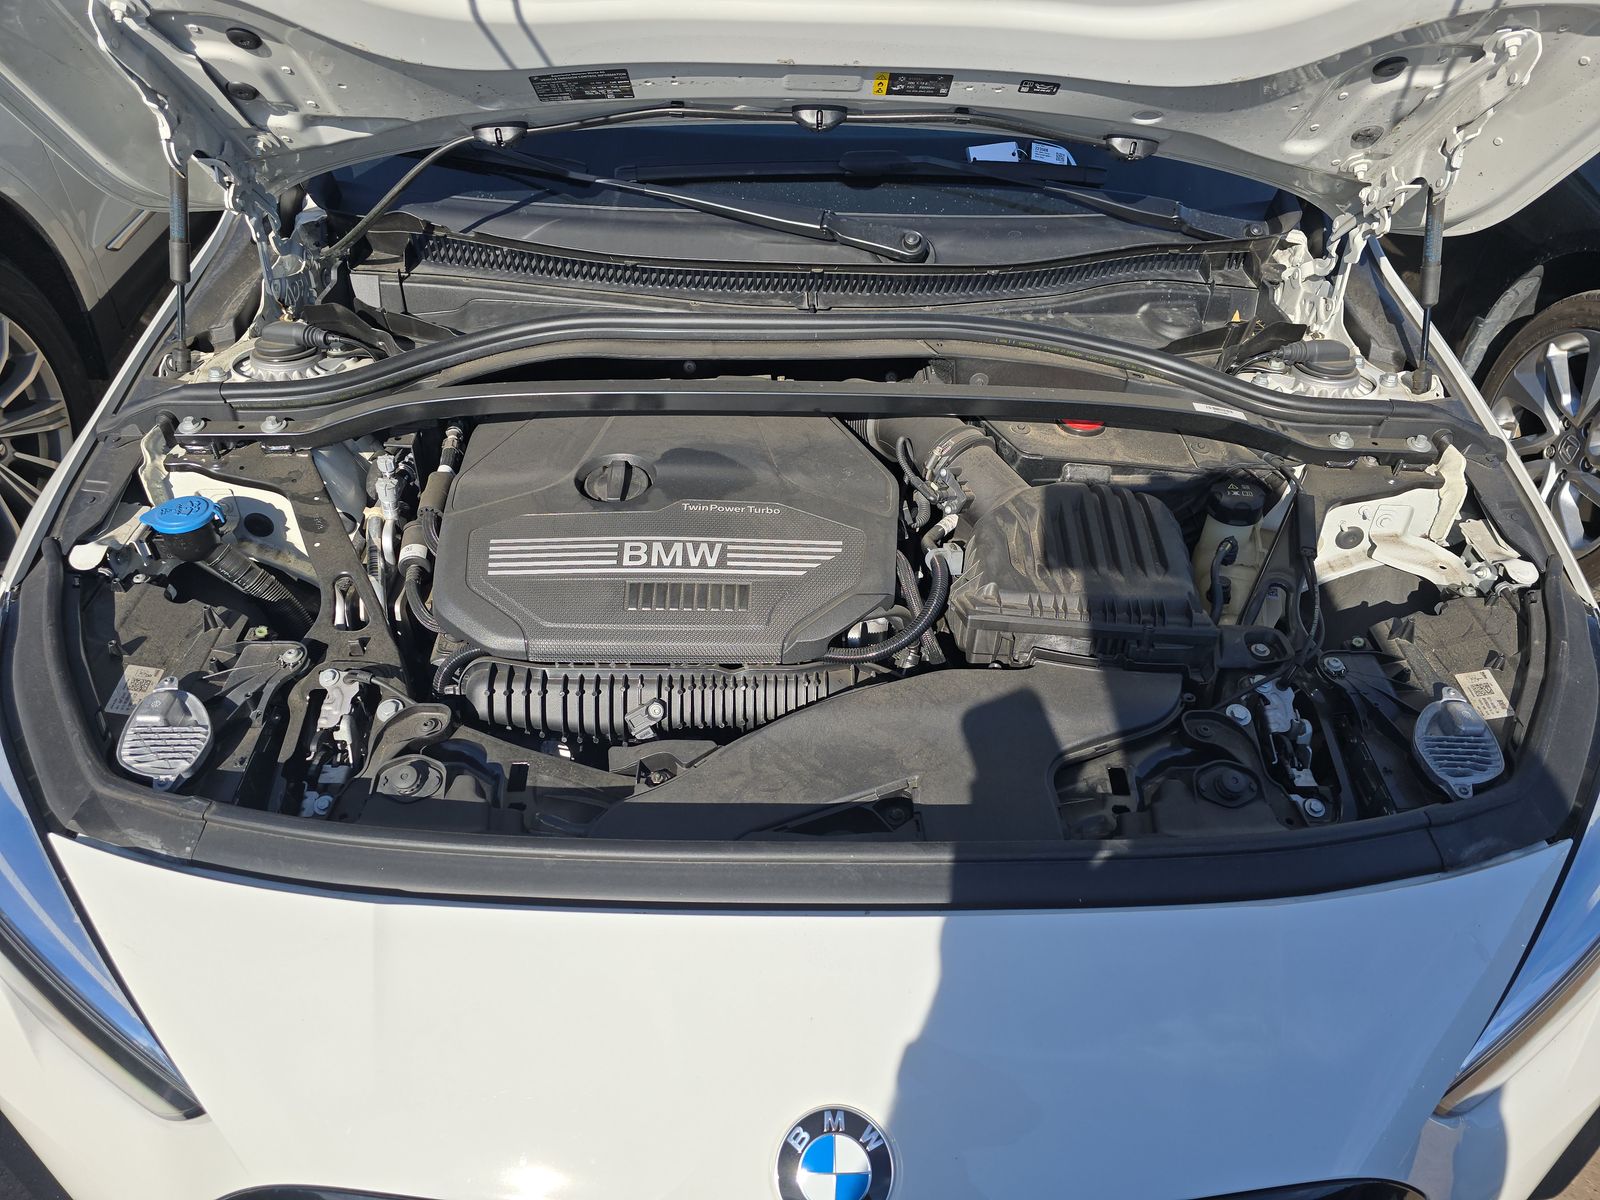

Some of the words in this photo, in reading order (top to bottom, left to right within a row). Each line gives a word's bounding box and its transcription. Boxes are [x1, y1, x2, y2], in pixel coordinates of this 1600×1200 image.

[747, 505, 781, 515] Turbo
[622, 541, 723, 567] BMW
[786, 1110, 884, 1154] BMW
